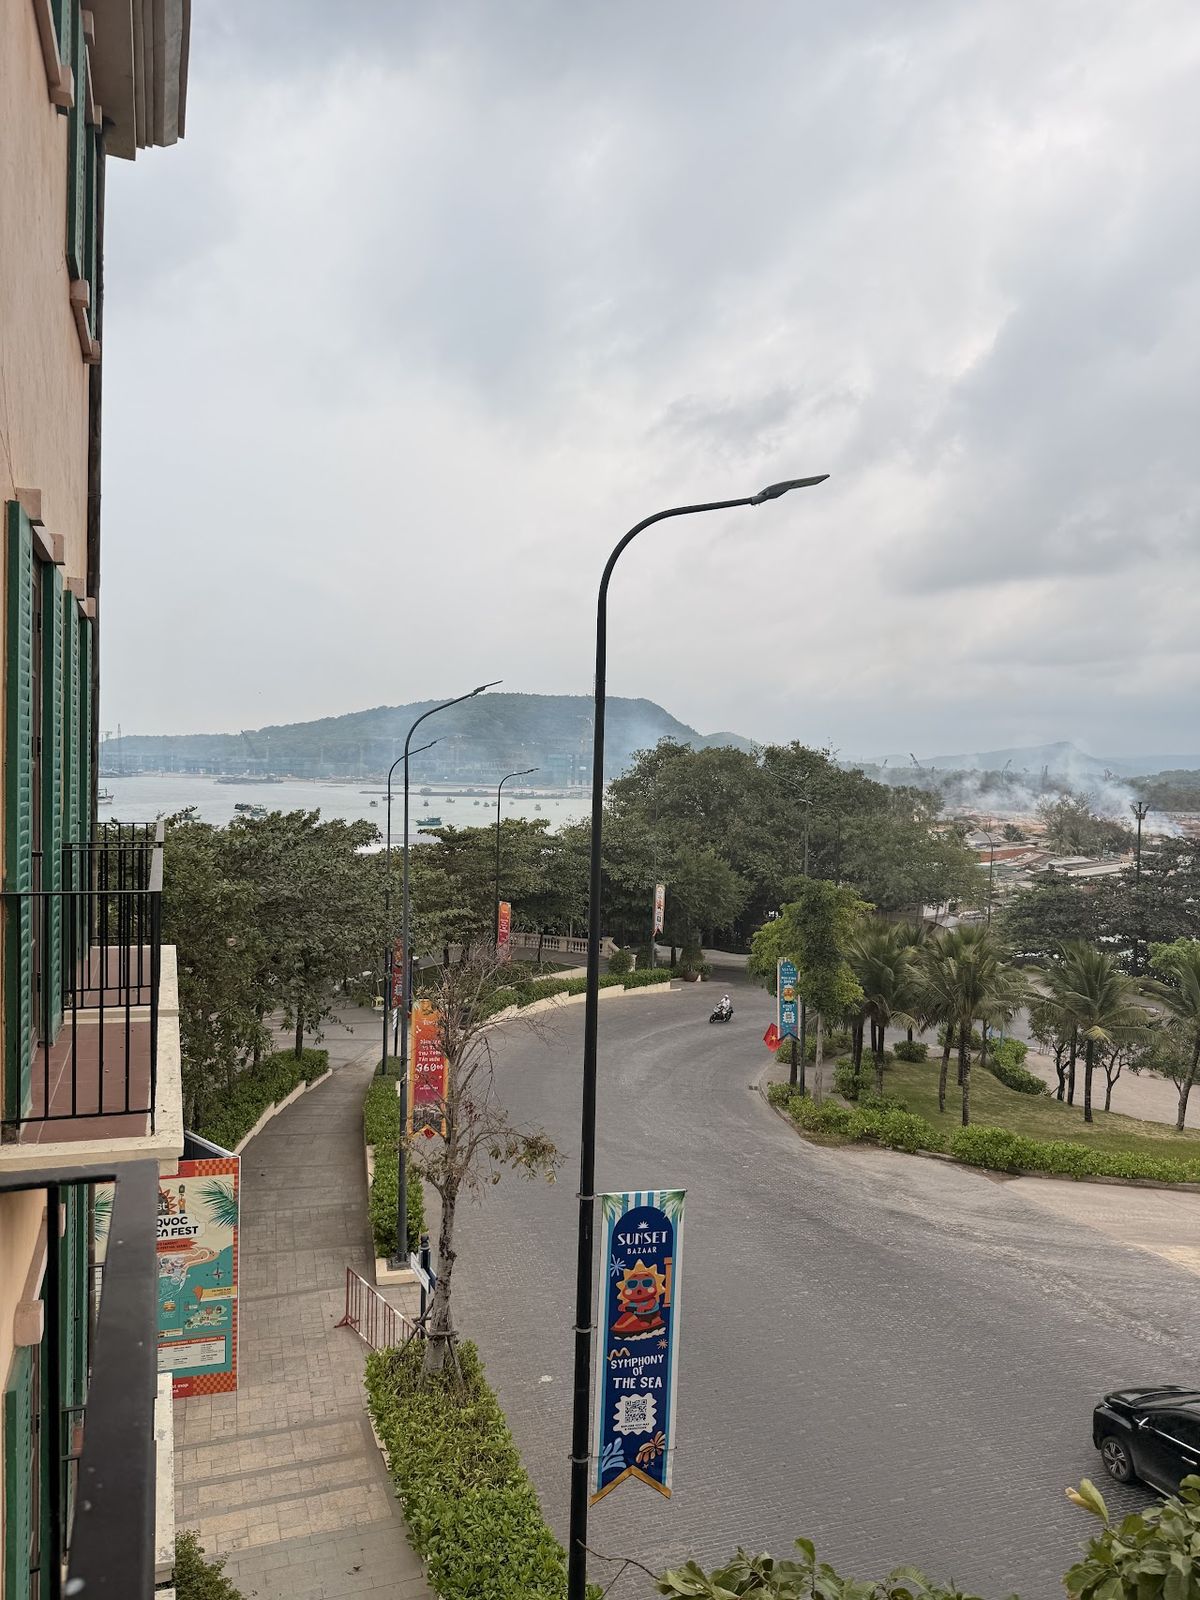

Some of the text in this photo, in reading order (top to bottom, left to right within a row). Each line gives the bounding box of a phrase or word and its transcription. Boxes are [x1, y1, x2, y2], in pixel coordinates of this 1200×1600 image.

[171, 1226, 199, 1236] FEST
[617, 1231, 668, 1246] SUNSET
[627, 1246, 657, 1255] BAZAAR
[610, 1354, 664, 1370] SYMPHONY
[632, 1365, 644, 1376] OF
[612, 1376, 663, 1389] THE SEA
